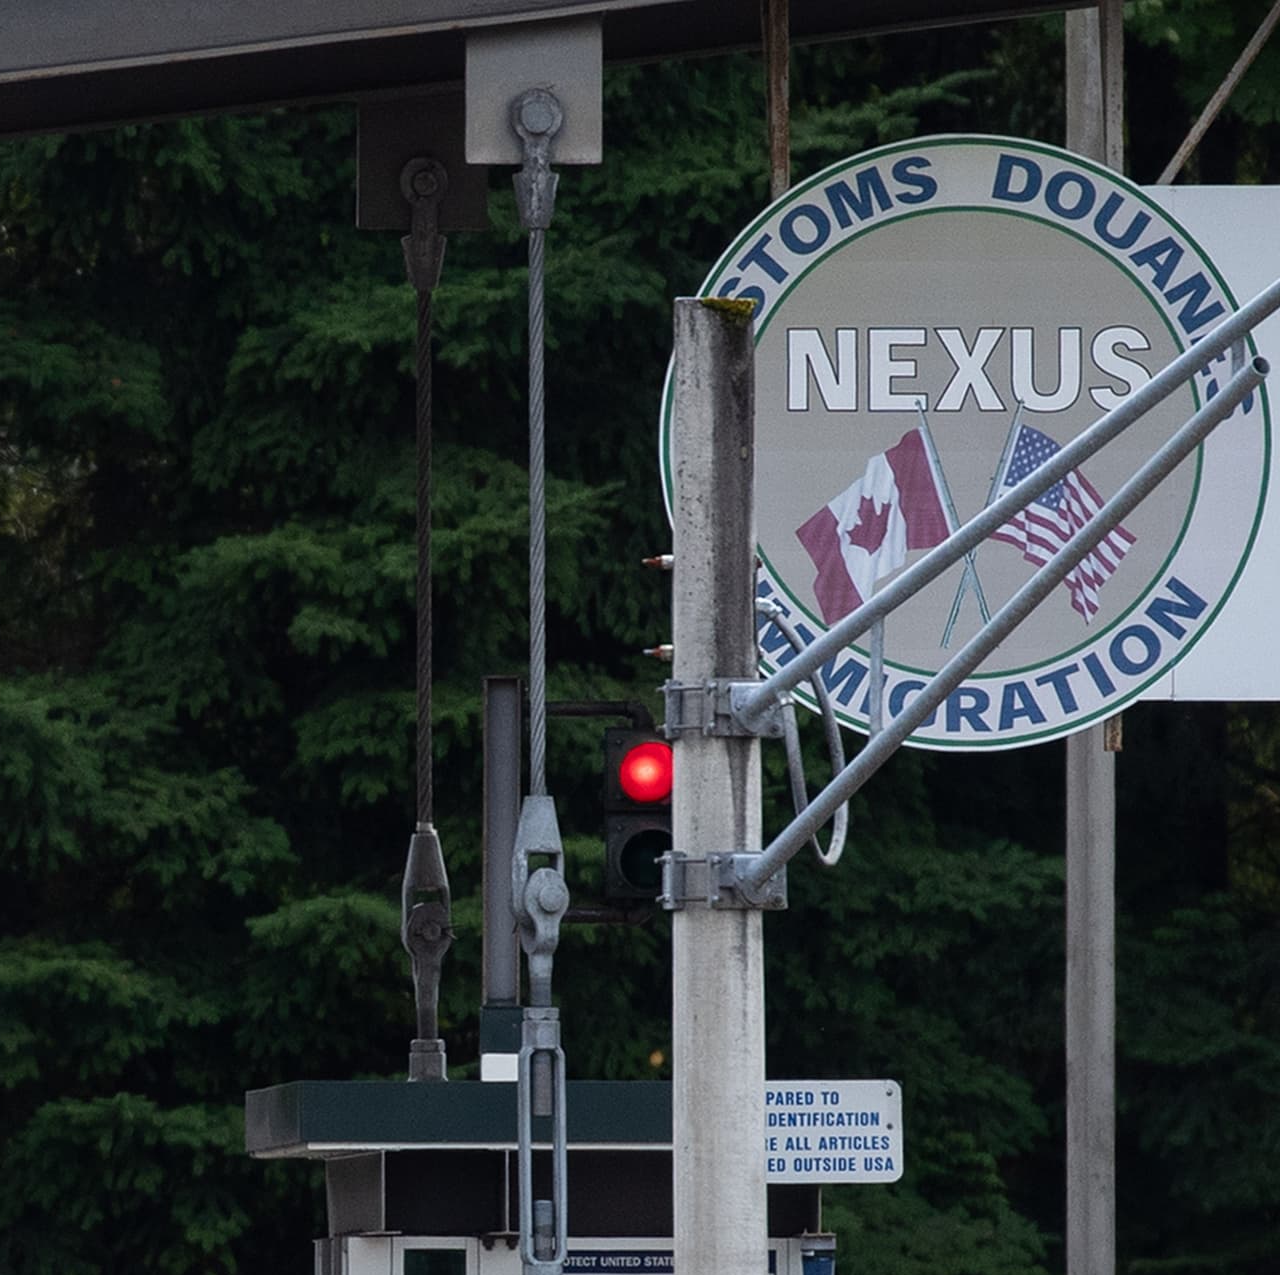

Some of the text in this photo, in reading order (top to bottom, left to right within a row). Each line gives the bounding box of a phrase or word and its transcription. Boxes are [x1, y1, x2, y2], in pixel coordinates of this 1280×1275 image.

[786, 325, 1152, 413] NEXUS
[822, 1091, 839, 1105] TO
[786, 1137, 811, 1151] ALL
[819, 1136, 890, 1150] ARTICLES
[794, 1157, 856, 1172] OUTSIDE
[864, 1157, 894, 1171] USA
[601, 1256, 641, 1267] UNITED
